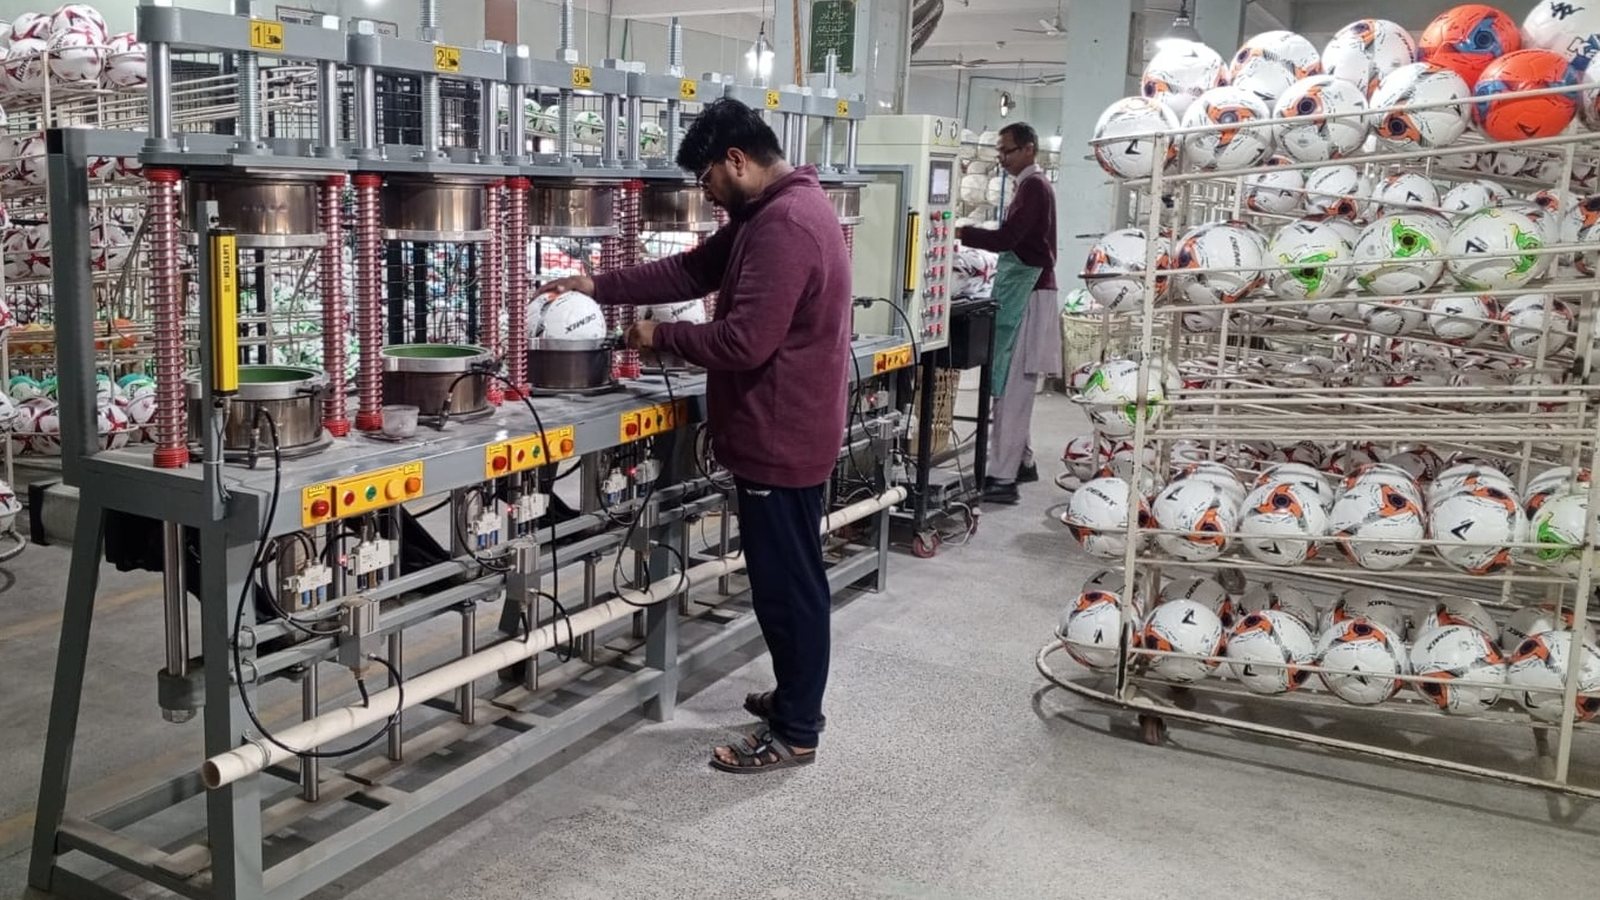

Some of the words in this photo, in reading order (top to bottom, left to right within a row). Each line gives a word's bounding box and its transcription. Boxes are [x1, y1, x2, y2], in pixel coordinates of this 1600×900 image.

[253, 25, 261, 44] 1
[437, 49, 445, 67] 2
[574, 68, 580, 84] 3
[1085, 487, 1118, 506] DEMIX
